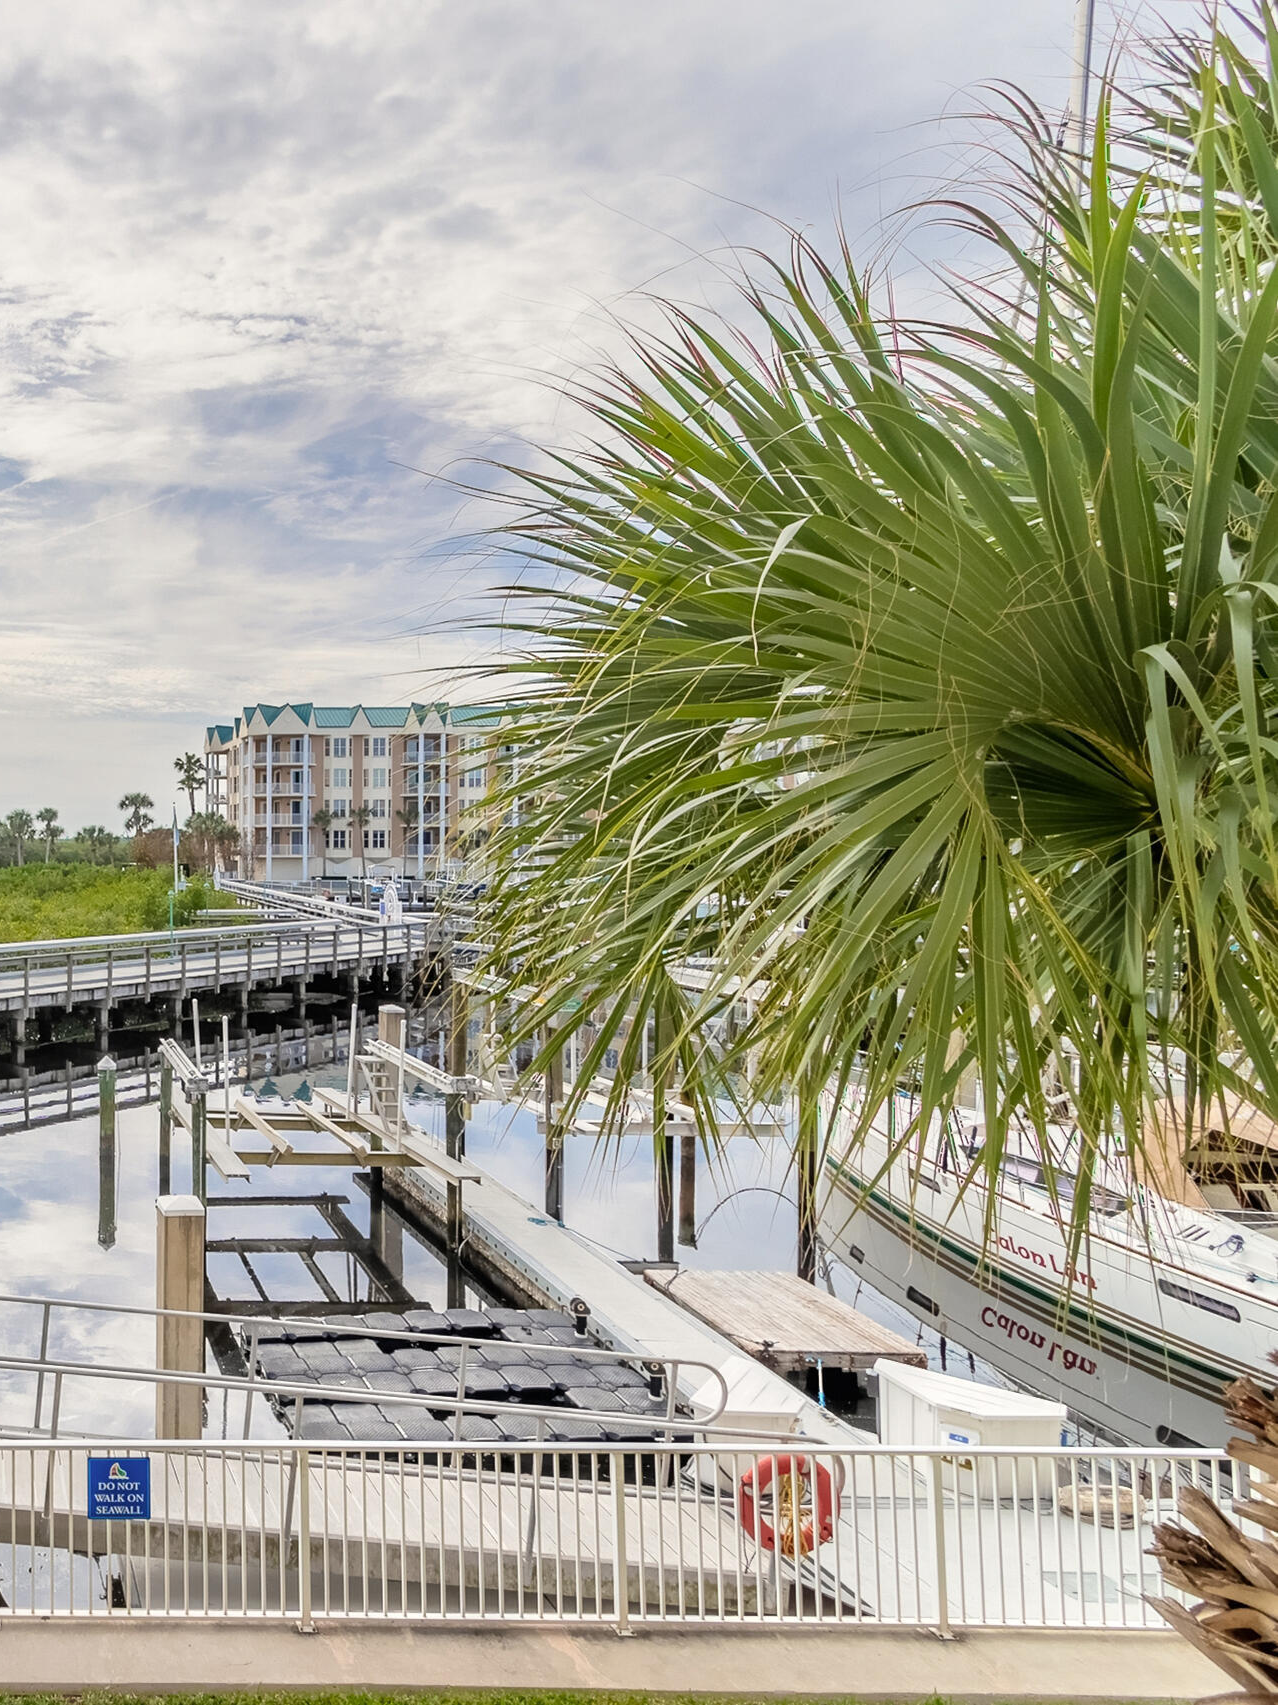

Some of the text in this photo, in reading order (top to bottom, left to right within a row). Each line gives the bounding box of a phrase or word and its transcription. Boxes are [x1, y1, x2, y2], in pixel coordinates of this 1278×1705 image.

[985, 1226, 1047, 1268] alon
[98, 1482, 140, 1490] DO NOT
[94, 1494, 144, 1502] WALK ON
[96, 1506, 143, 1514] SEAWALL
